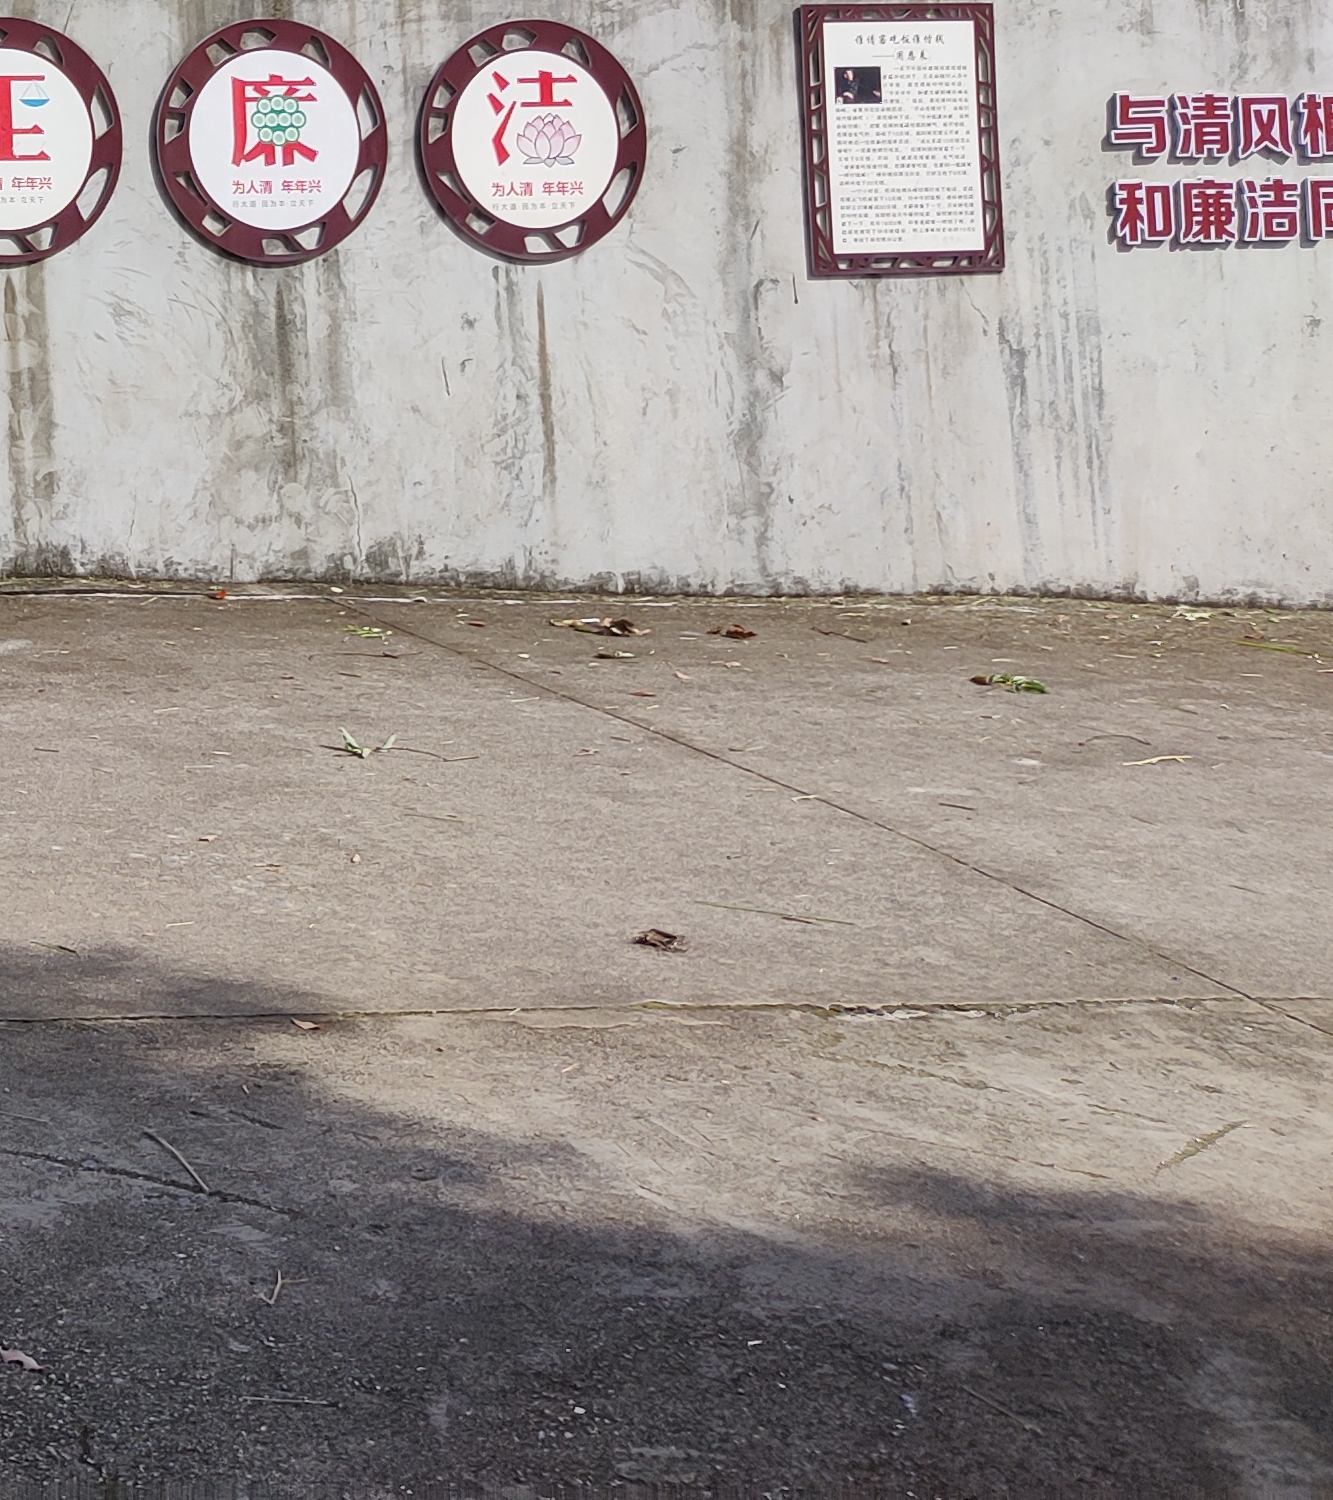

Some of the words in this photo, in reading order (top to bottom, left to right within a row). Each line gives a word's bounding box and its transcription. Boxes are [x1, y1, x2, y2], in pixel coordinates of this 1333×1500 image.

[11, 176, 53, 191] 年年兴
[232, 180, 273, 194] 为人清
[281, 179, 322, 193] 年年兴
[491, 181, 533, 197] 为人清
[542, 181, 584, 196] 年年兴
